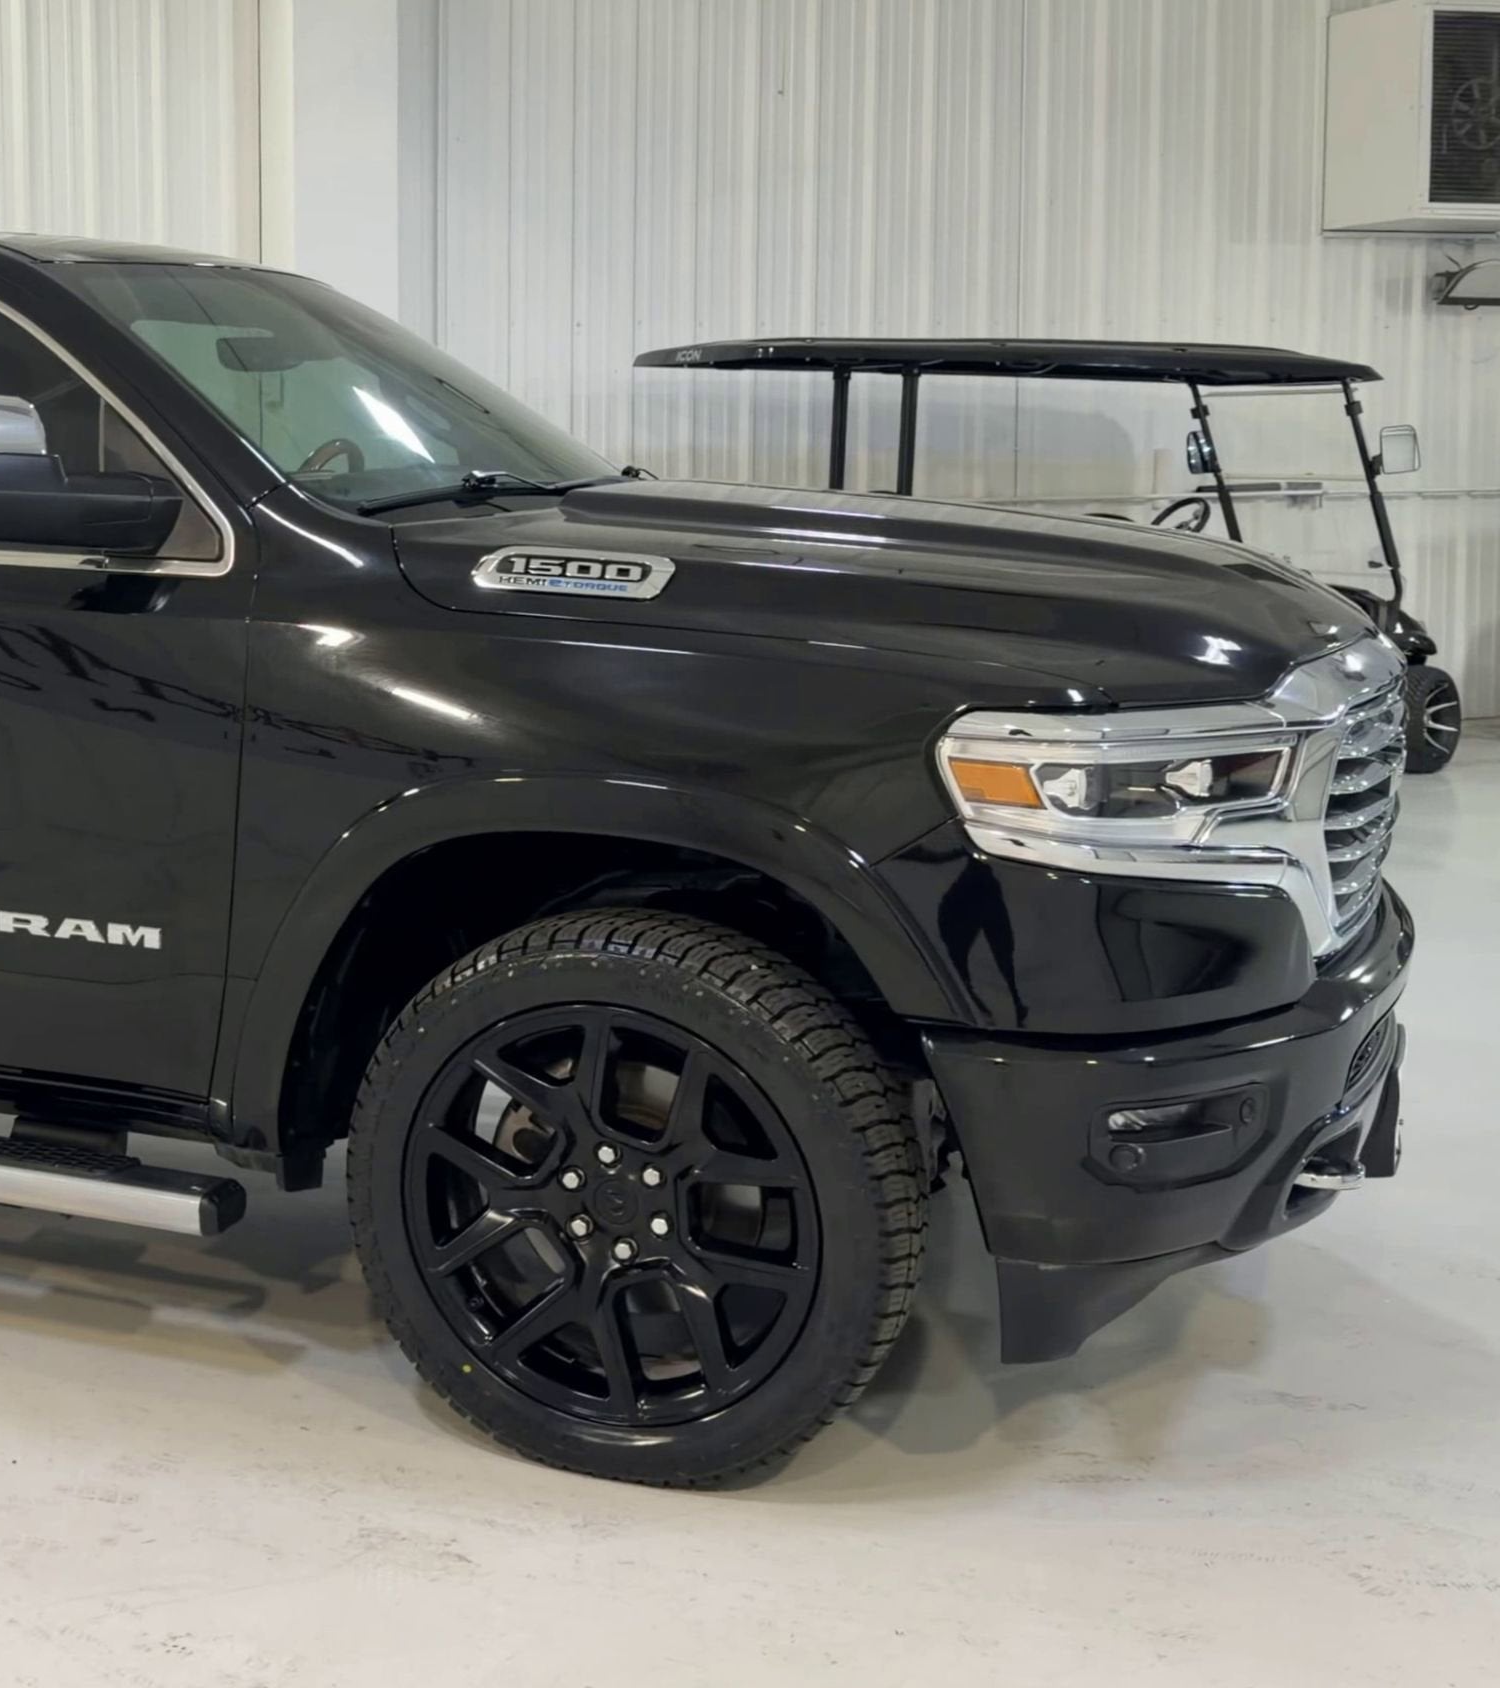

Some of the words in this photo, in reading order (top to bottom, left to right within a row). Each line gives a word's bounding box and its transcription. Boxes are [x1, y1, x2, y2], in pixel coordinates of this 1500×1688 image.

[676, 349, 702, 362] ICON
[509, 557, 643, 581] 1500
[499, 575, 547, 586] HEMI
